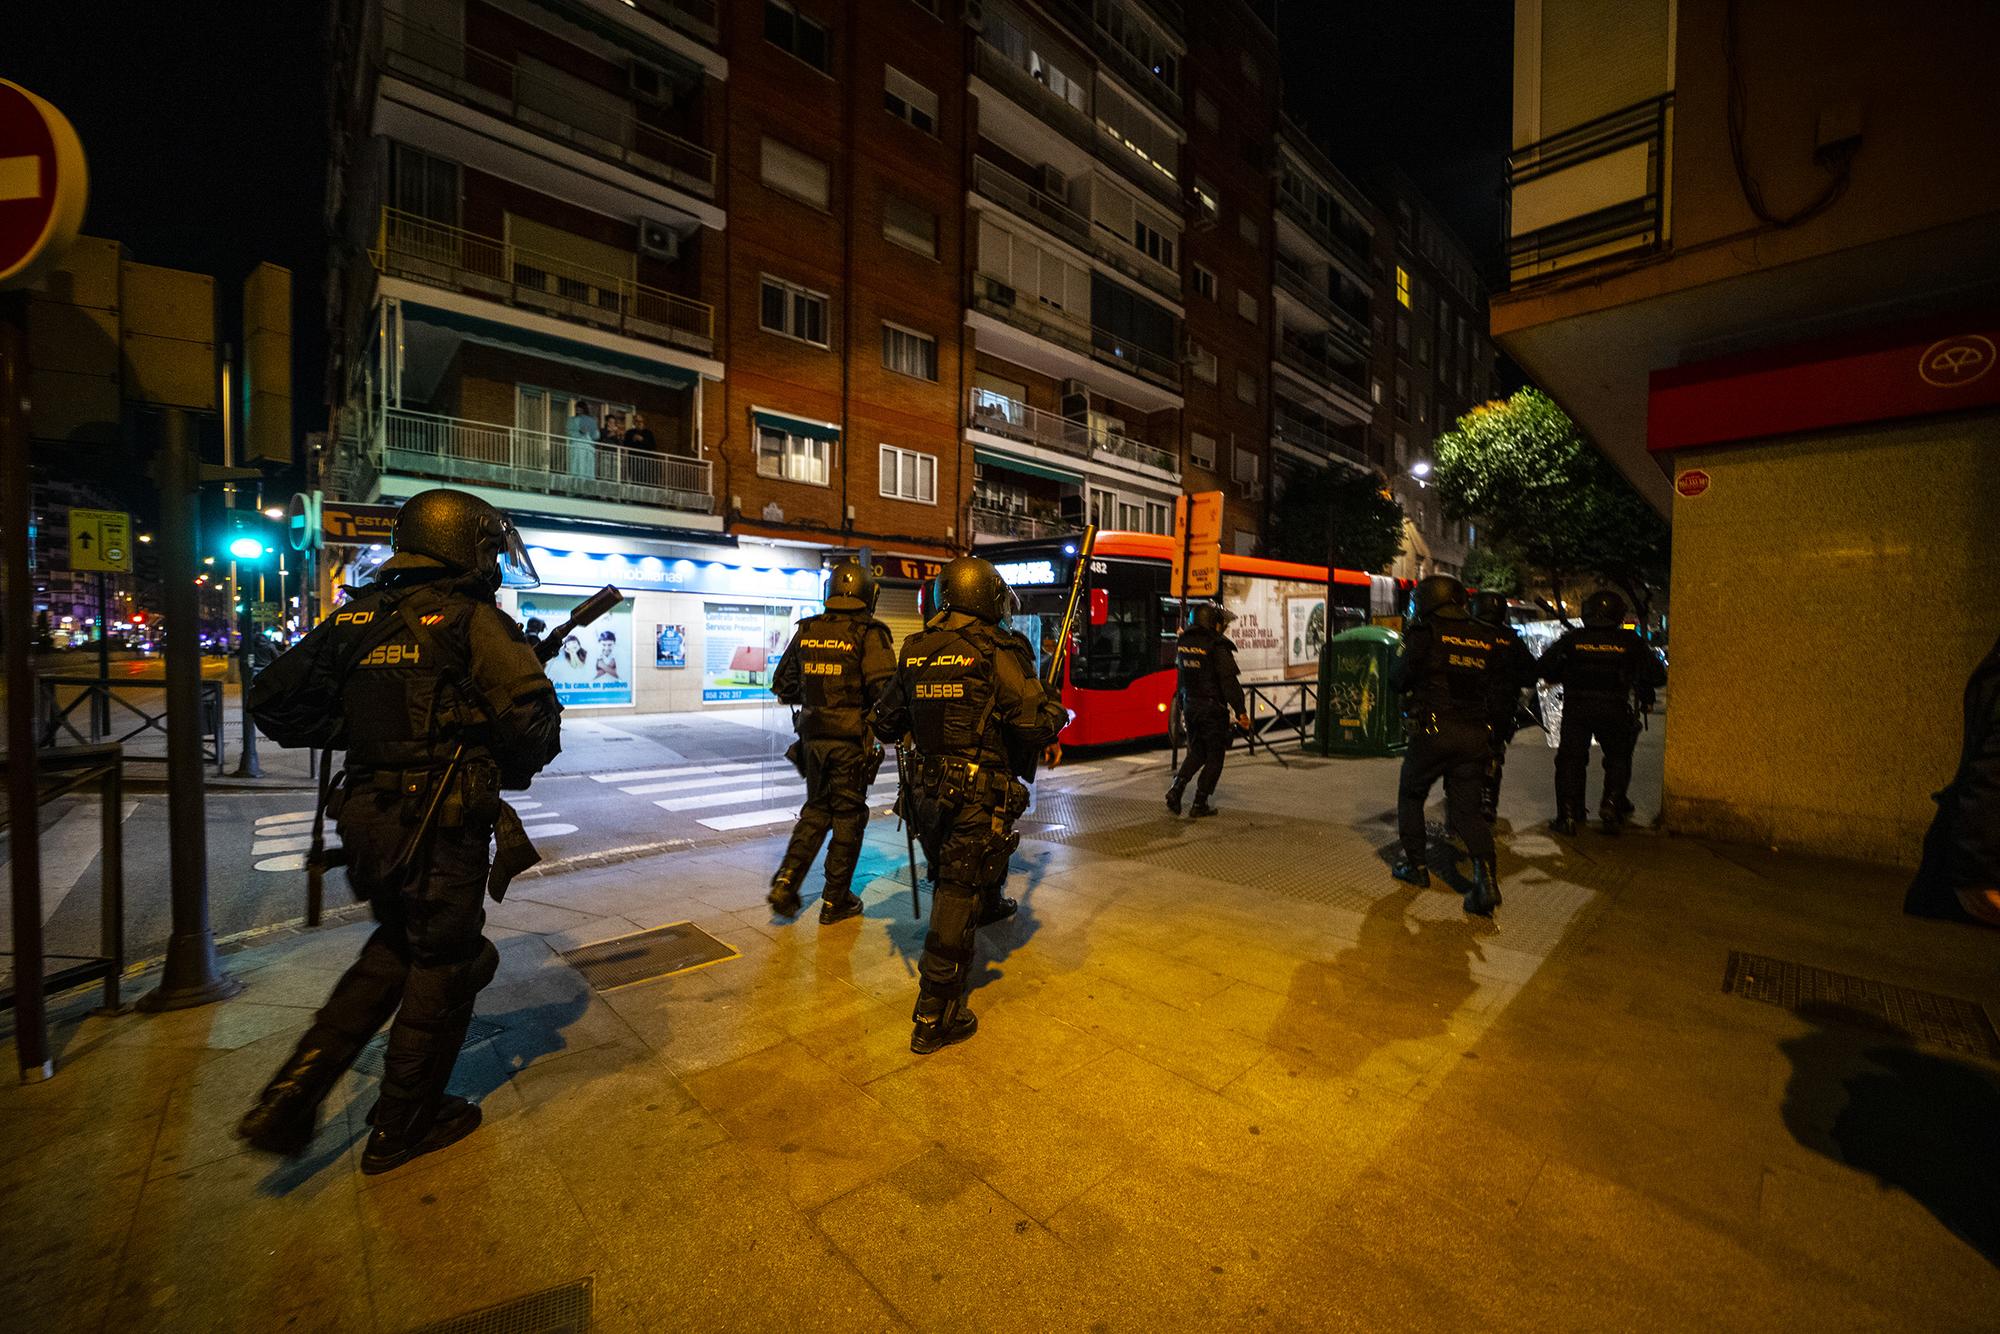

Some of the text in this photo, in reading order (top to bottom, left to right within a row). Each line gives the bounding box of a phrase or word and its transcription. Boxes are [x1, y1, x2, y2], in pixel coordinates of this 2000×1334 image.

[354, 516, 395, 527] ESTA
[1090, 561, 1107, 574] 482
[706, 622, 732, 631] Servicio
[801, 639, 846, 650] POLICIA
[360, 644, 420, 664] 584
